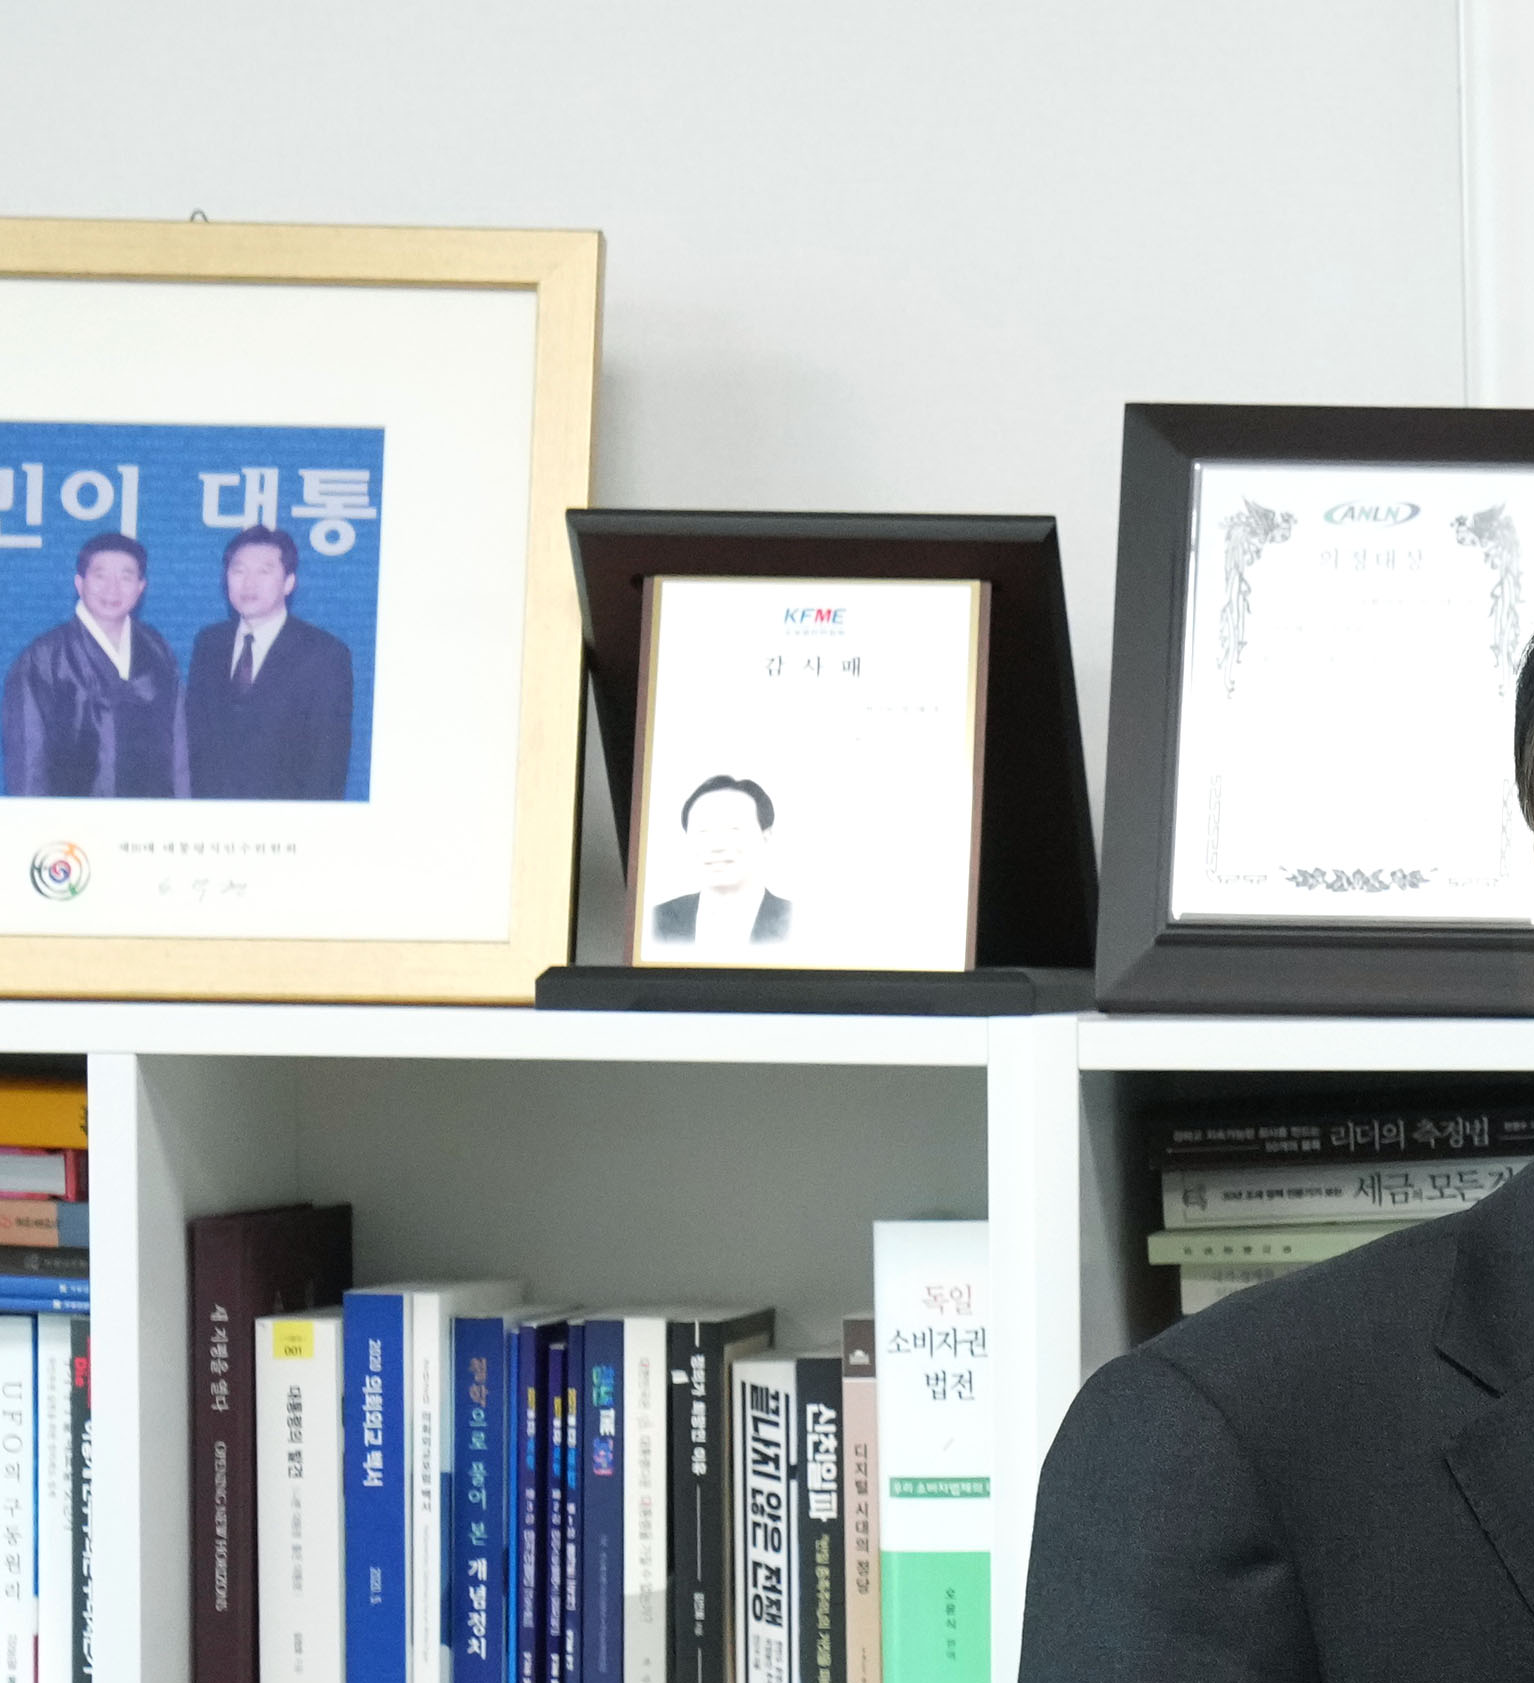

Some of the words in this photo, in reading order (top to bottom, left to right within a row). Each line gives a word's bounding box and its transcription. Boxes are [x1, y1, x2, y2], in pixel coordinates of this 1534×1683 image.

[198, 468, 377, 556] 대통
[784, 608, 847, 624] KFME
[922, 1283, 972, 1316] 독일
[887, 1326, 988, 1359] 소비자권
[924, 1368, 975, 1401] 법전
[750, 1383, 781, 1482] 끝나지
[806, 1403, 839, 1522] 신친일파
[751, 1487, 782, 1554] 않은
[466, 1556, 487, 1661] 개념정치
[751, 1559, 783, 1628] 전쟁
